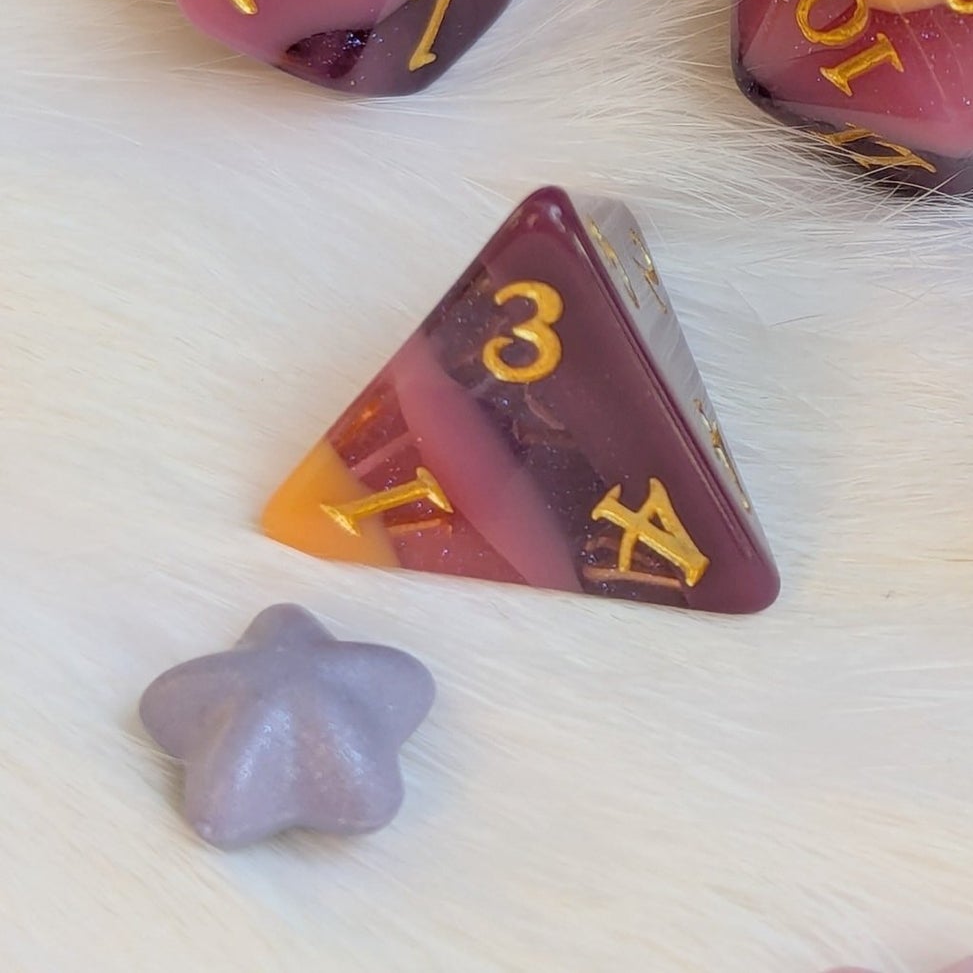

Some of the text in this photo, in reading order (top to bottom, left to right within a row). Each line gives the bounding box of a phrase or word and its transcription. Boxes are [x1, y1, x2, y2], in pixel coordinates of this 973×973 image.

[482, 279, 565, 384] 3
[320, 466, 455, 537] 1
[590, 477, 711, 587] 4
